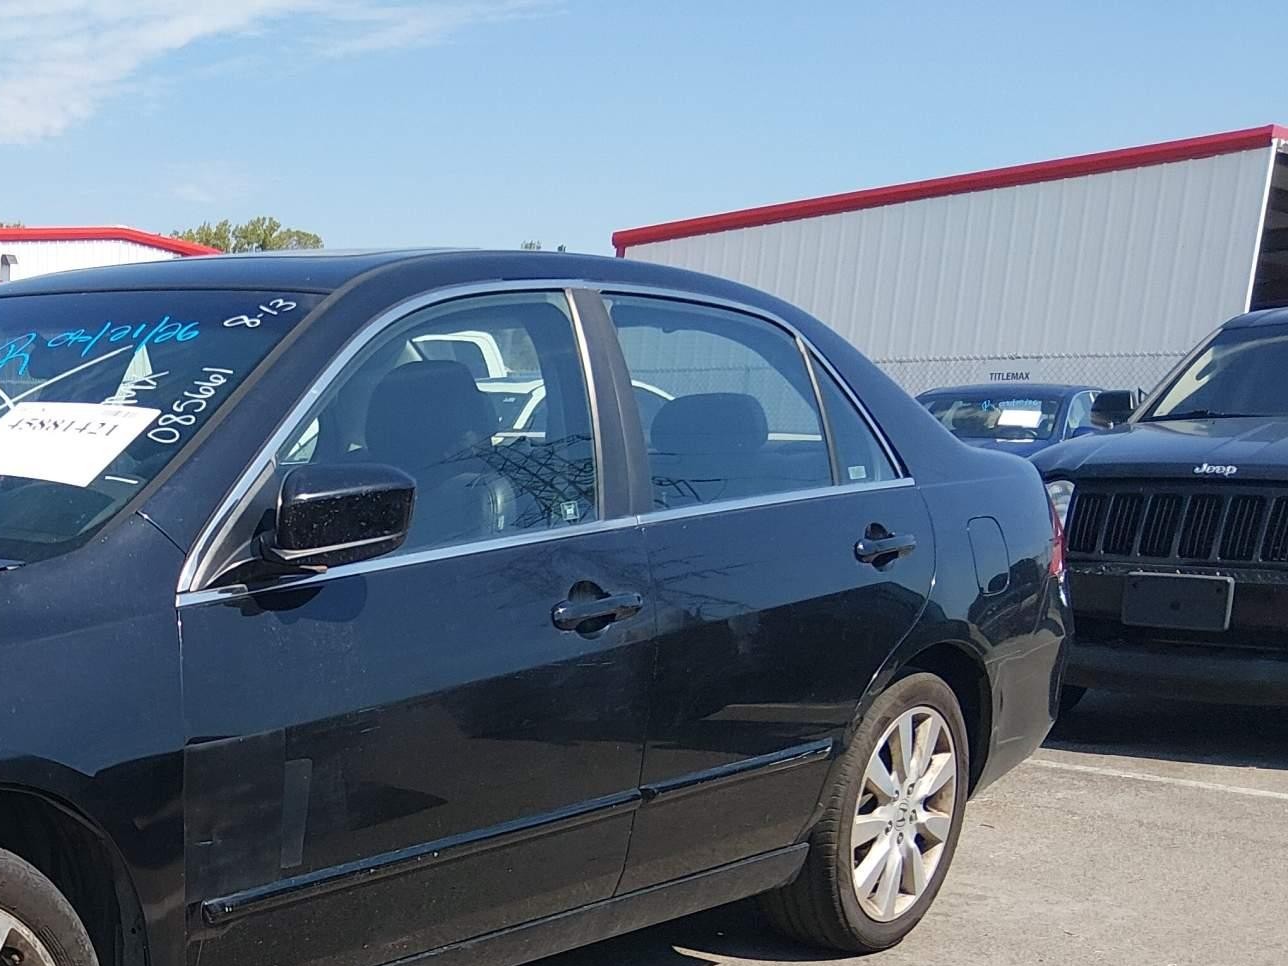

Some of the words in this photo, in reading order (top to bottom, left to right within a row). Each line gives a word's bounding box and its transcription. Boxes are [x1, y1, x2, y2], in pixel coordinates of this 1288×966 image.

[223, 298, 297, 328] 8-13
[989, 372, 1030, 381] TITLEMAX
[147, 367, 234, 444] 085661
[1193, 463, 1238, 478] Jeep
